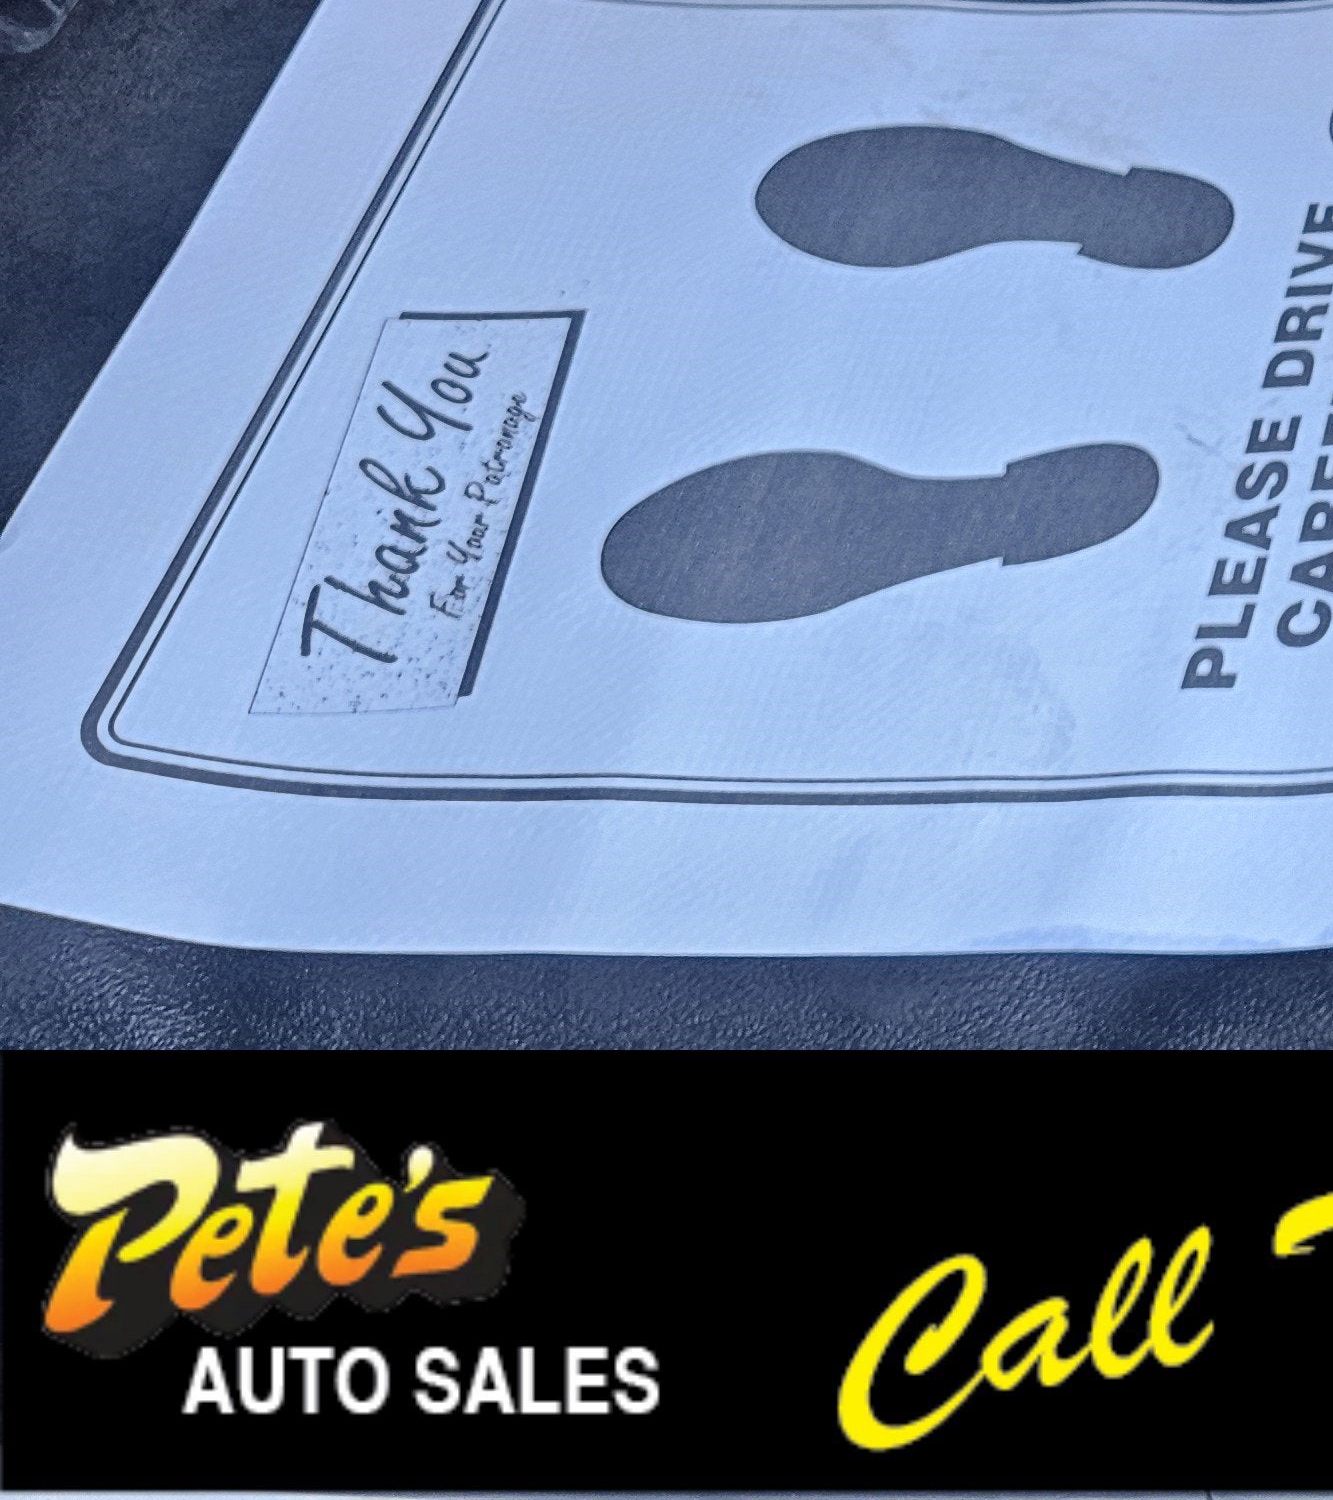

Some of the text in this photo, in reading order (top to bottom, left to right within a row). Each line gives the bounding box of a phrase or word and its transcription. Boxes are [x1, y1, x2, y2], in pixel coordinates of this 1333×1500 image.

[301, 348, 490, 663] Thank You
[1180, 416, 1302, 691] PLEASE
